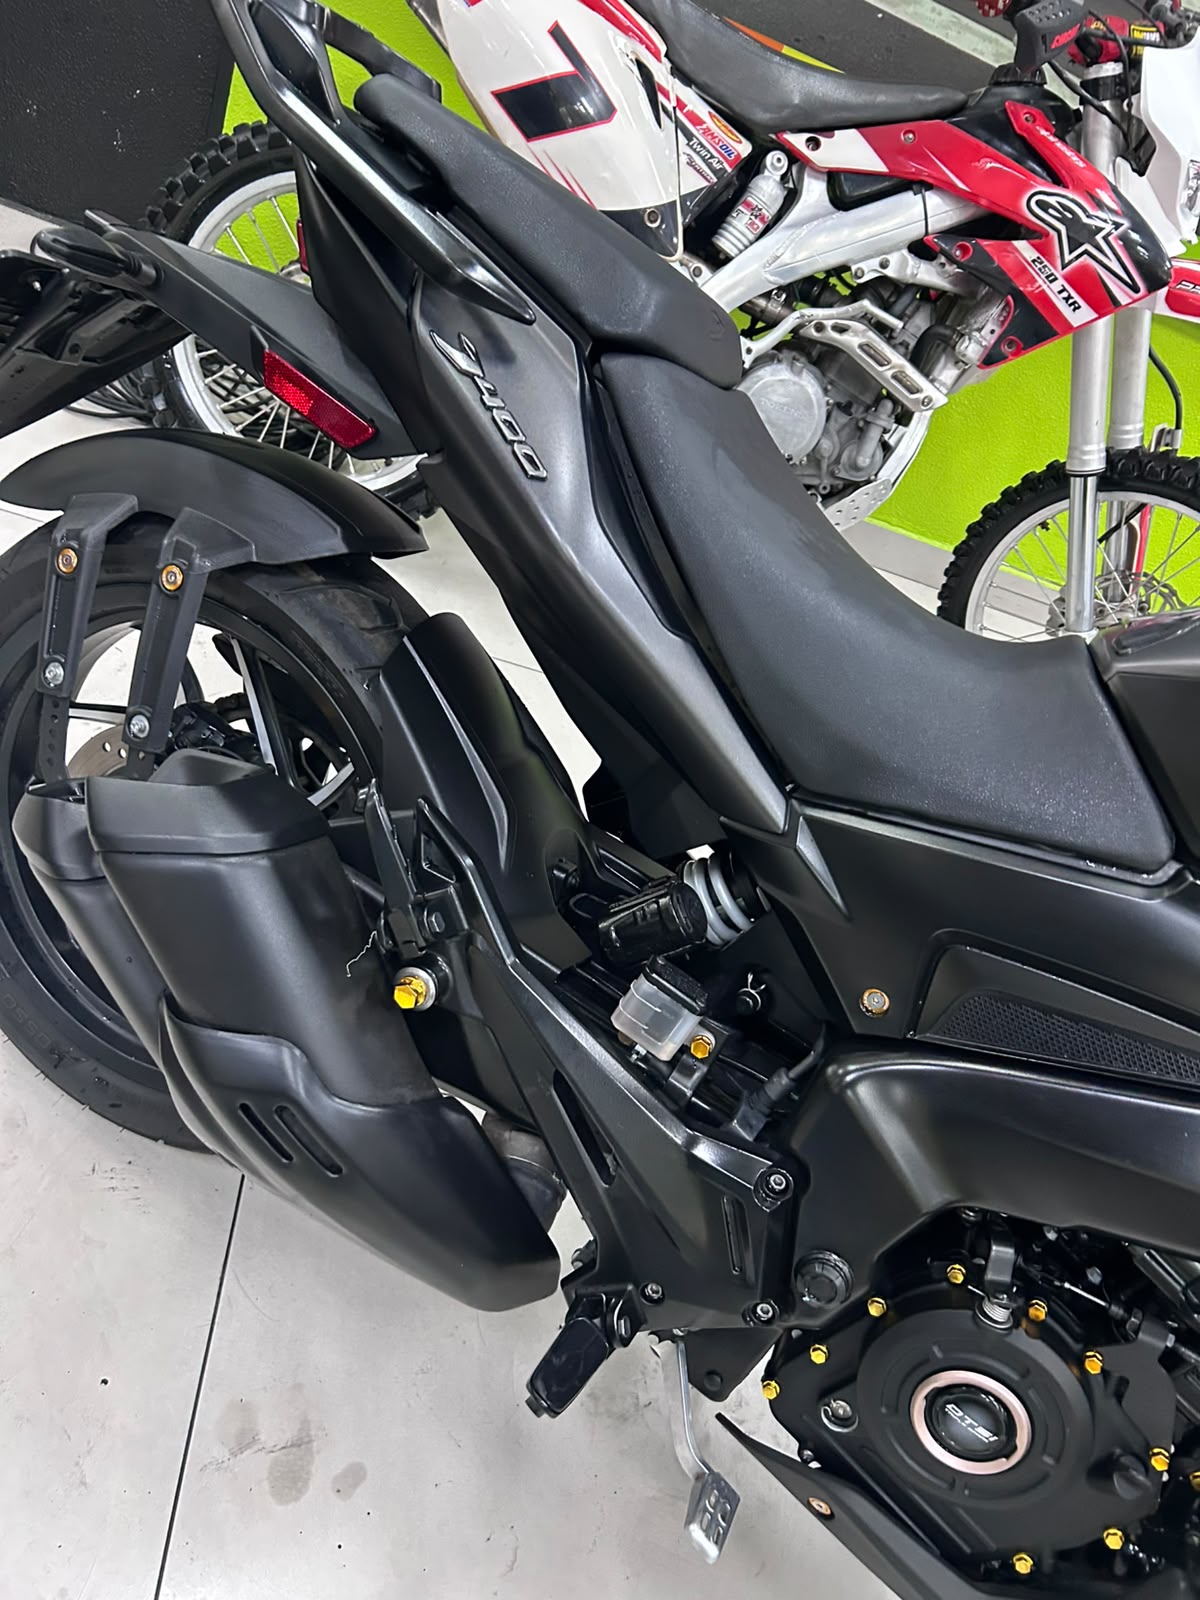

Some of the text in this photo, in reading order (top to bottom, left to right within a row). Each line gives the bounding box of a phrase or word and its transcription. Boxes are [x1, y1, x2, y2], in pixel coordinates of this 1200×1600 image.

[689, 137, 711, 161] Twin
[707, 157, 724, 171] Air
[700, 124, 735, 159] AMSOIL
[1030, 255, 1082, 313] 250 TXR
